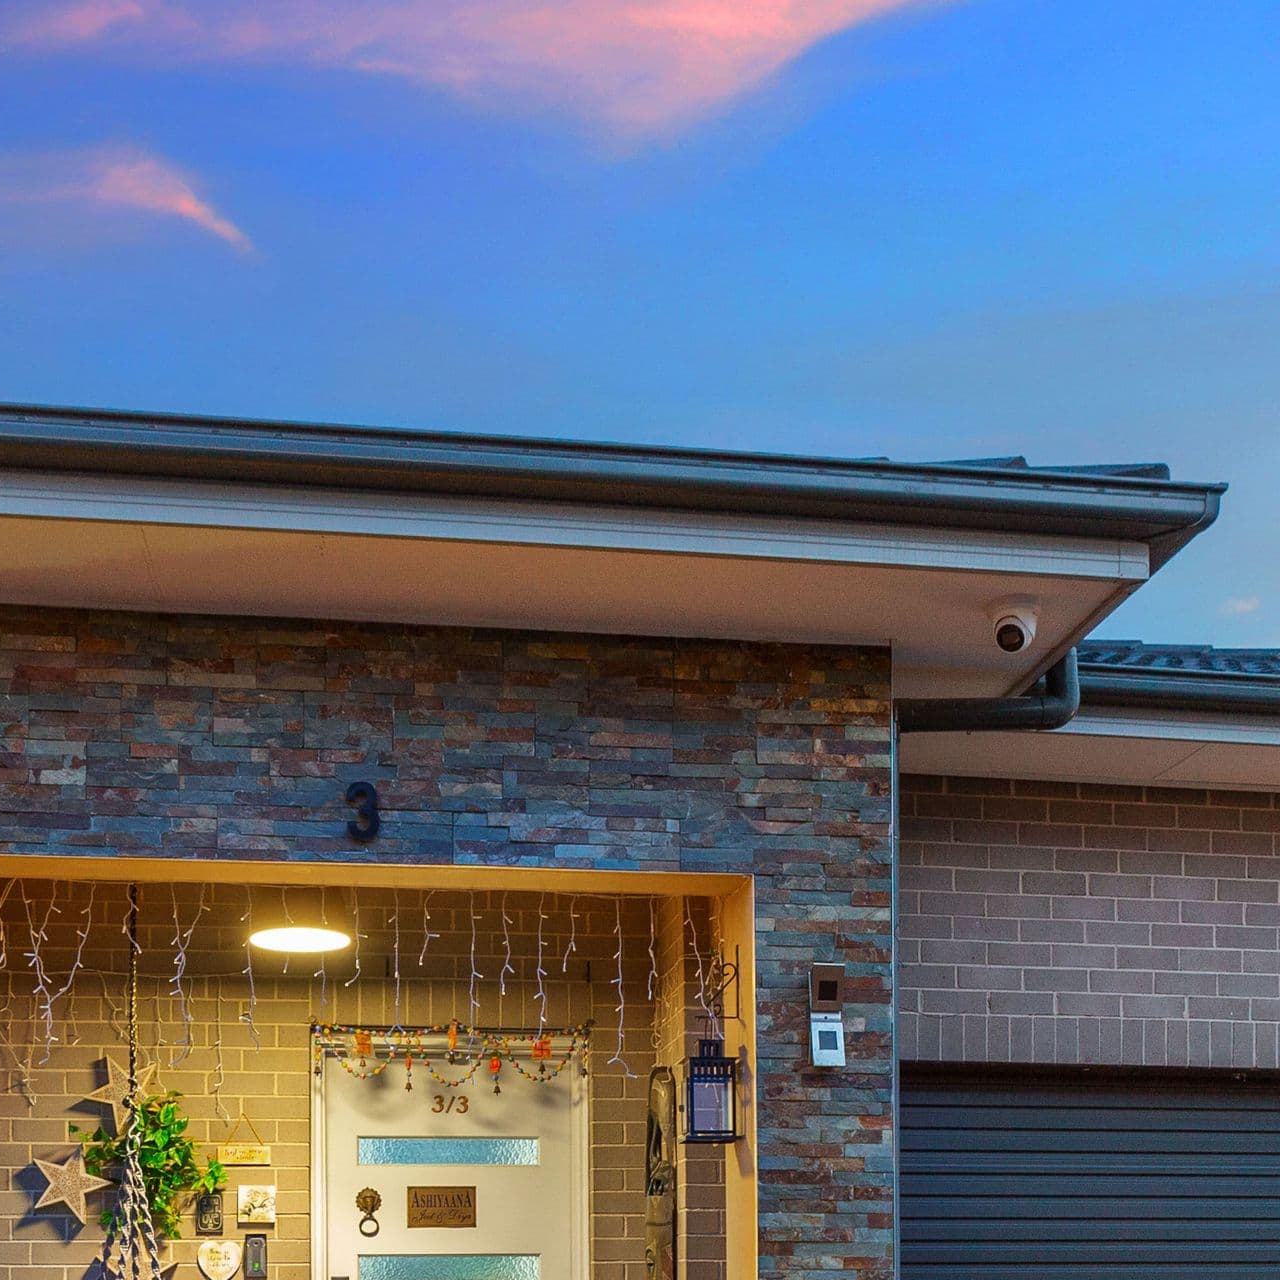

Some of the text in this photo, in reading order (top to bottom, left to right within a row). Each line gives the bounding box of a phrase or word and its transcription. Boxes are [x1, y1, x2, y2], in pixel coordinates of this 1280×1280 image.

[346, 781, 379, 842] 3
[431, 1095, 469, 1114] 3/3
[411, 1190, 473, 1209] ASHIYAANA
